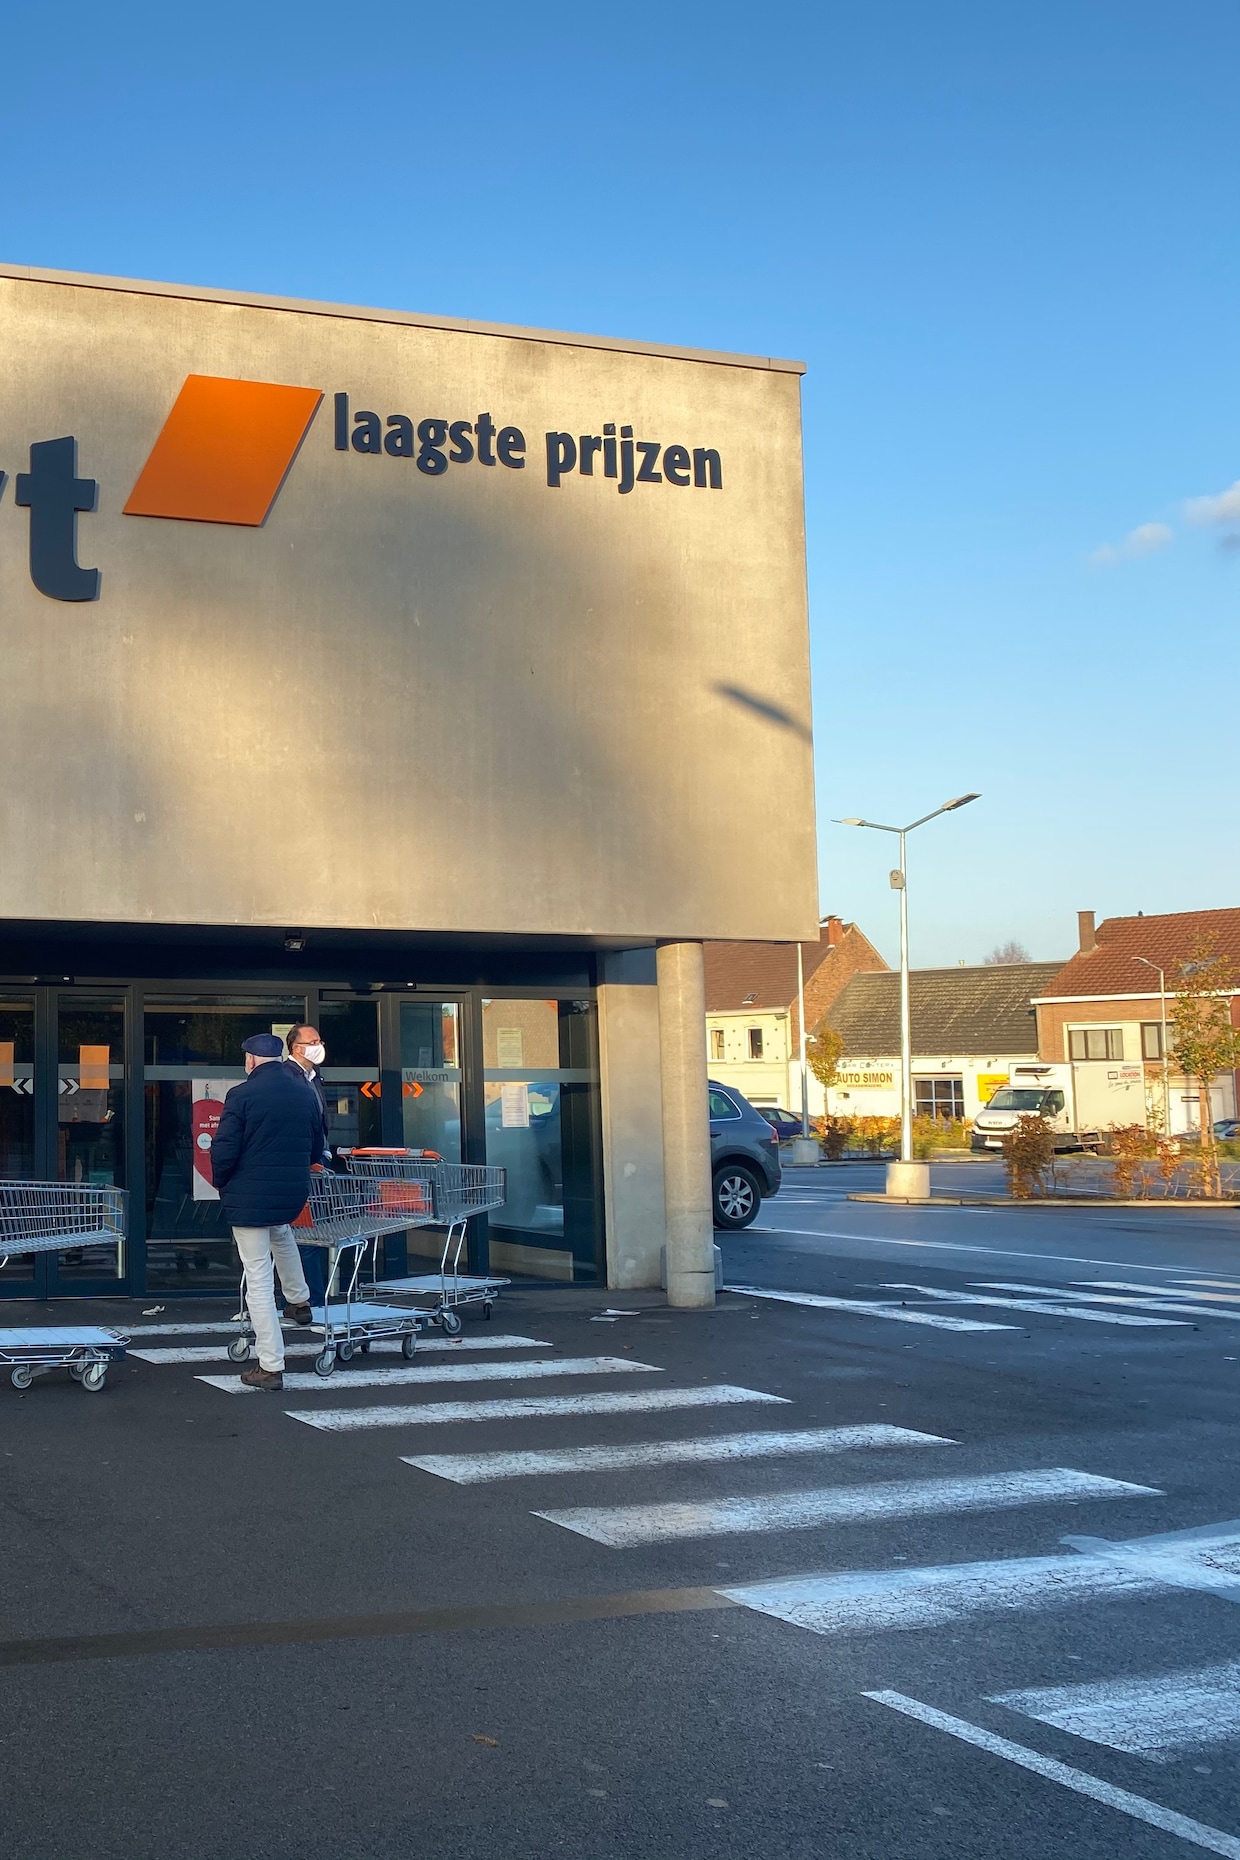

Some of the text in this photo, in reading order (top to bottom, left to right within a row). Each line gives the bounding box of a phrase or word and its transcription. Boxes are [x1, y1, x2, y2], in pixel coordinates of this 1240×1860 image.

[334, 392, 723, 494] laagste prijzen
[405, 1070, 449, 1081] Welkom
[837, 1072, 893, 1083] AUTO SIMON
